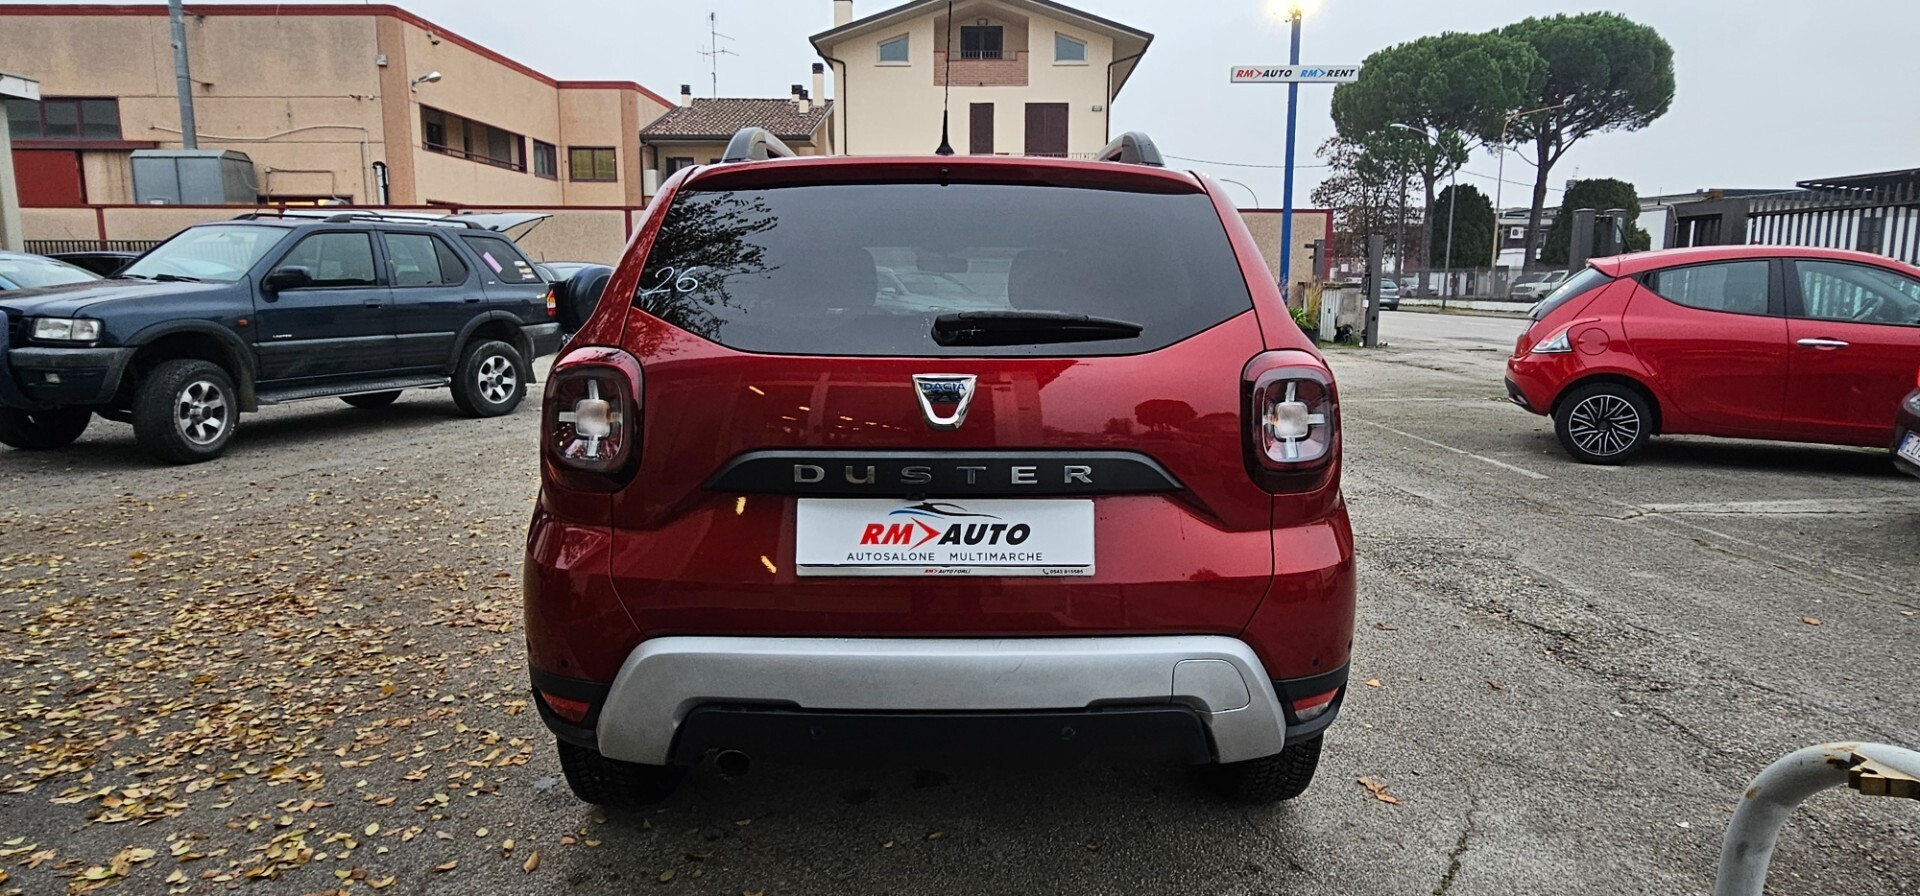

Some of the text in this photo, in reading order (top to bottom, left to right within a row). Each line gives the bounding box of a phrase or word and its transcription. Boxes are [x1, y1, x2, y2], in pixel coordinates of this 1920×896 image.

[1261, 69, 1293, 78] AUTO
[1326, 69, 1356, 77] RENT
[639, 266, 698, 296] 26
[923, 382, 966, 391] DACIA
[794, 464, 1093, 485] DUSTER
[937, 523, 1031, 545] AUTO
[846, 552, 1043, 562] AUTOSALONE MULTIMARCHE
